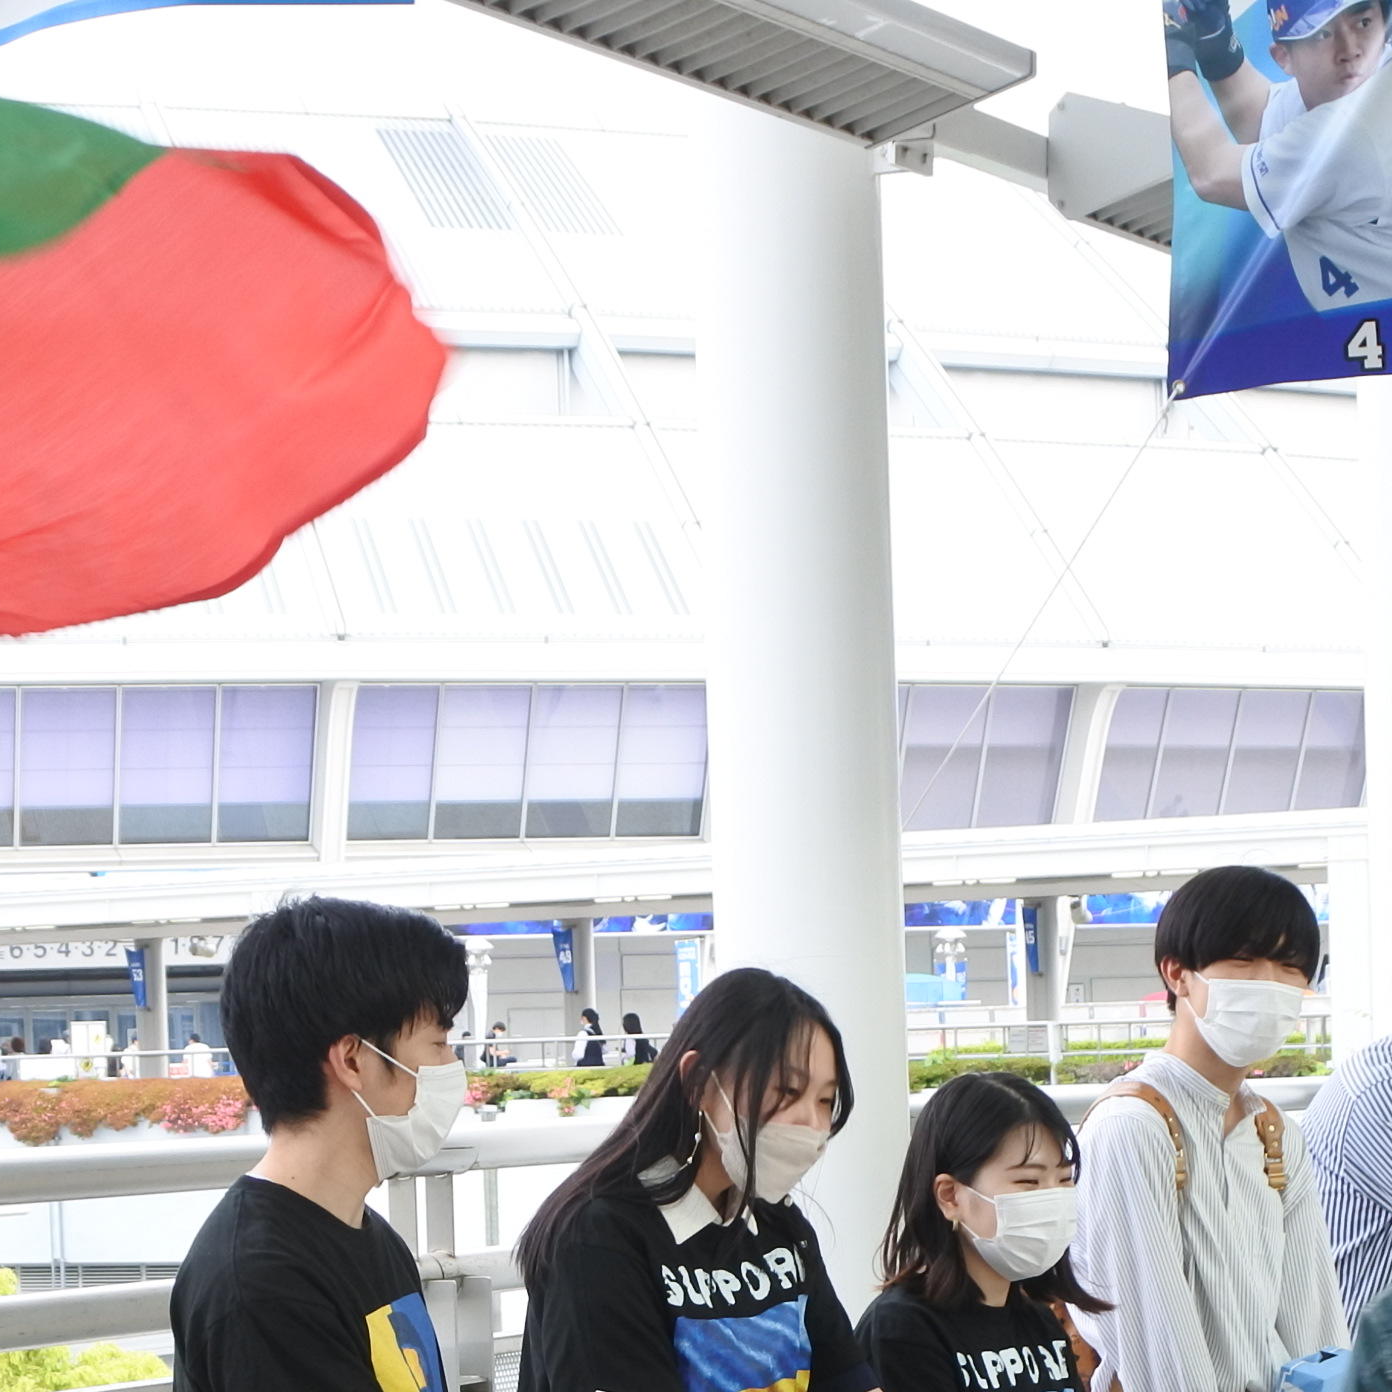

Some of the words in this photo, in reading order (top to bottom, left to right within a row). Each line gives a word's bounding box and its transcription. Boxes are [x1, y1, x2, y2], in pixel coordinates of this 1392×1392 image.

[1318, 255, 1360, 299] 4
[1346, 320, 1384, 370] 4
[661, 1242, 806, 1309] SUPPOR
